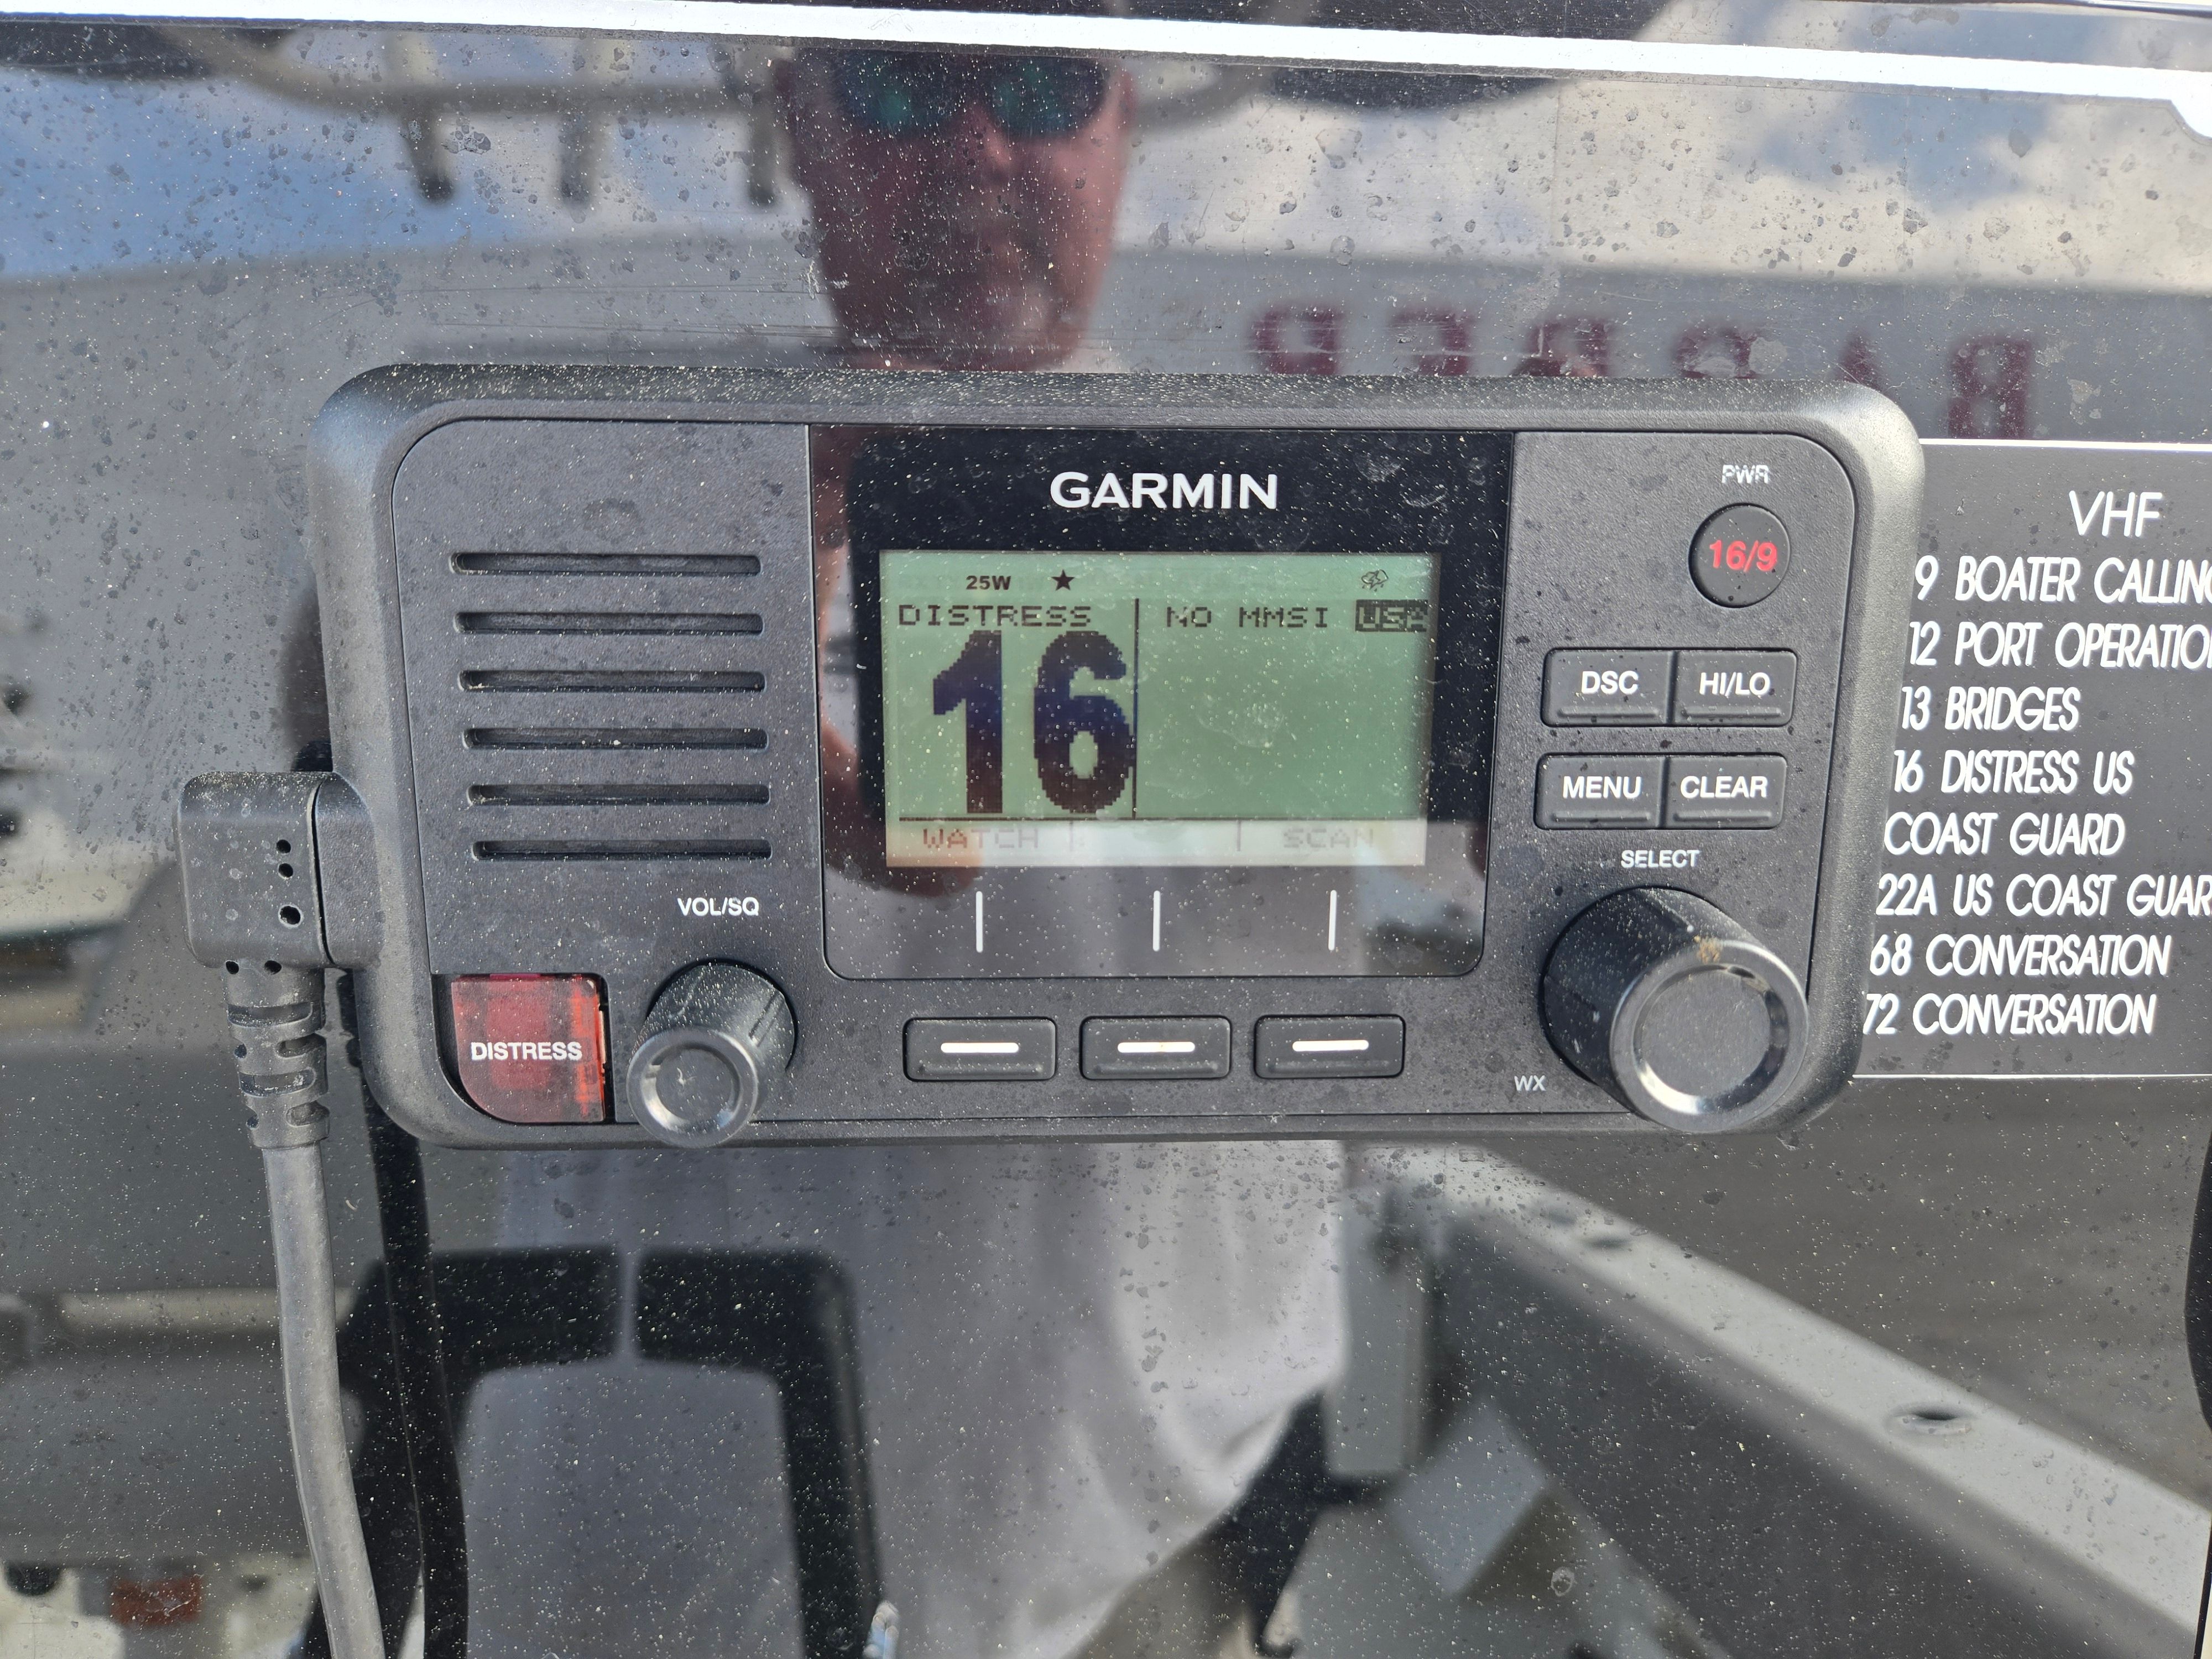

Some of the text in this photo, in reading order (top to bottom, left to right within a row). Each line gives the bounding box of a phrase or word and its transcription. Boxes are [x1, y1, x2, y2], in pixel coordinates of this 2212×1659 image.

[1721, 465, 1770, 483] PWR
[1050, 471, 1277, 509] GARMIN
[2069, 491, 2163, 537] VHF
[1709, 540, 1778, 572] 16/9
[966, 575, 1011, 591] 25W
[1914, 555, 1939, 601] 9
[1955, 555, 2080, 602] BOATER
[899, 604, 1091, 627] DISTRESS
[1166, 606, 1328, 628] NO MMSI
[1909, 620, 2212, 669] 12 PORT OPERATIO
[1580, 670, 1640, 695] DSC
[1699, 671, 1771, 697] HI/LO
[933, 629, 1136, 813] 16
[1901, 686, 2081, 731] 13 BRIDGES
[1893, 749, 2135, 795] 16 DISTRESS US
[1562, 775, 1642, 799] MENU
[1680, 775, 1768, 799] CLEAR
[923, 828, 1039, 849] WATCH
[1283, 828, 1374, 848] SCAN
[1884, 811, 2125, 856] COAST GUARD
[1620, 849, 1701, 869] SELECT
[677, 896, 760, 917] VOL/SQ
[1875, 873, 2212, 917] 22A US COAST GUAR
[1869, 933, 2172, 976] 68 CONVERSATION
[1863, 993, 2157, 1035] 72 CONVERSATION
[471, 1041, 582, 1061] DISTRESS
[1514, 1074, 1547, 1092] WX
